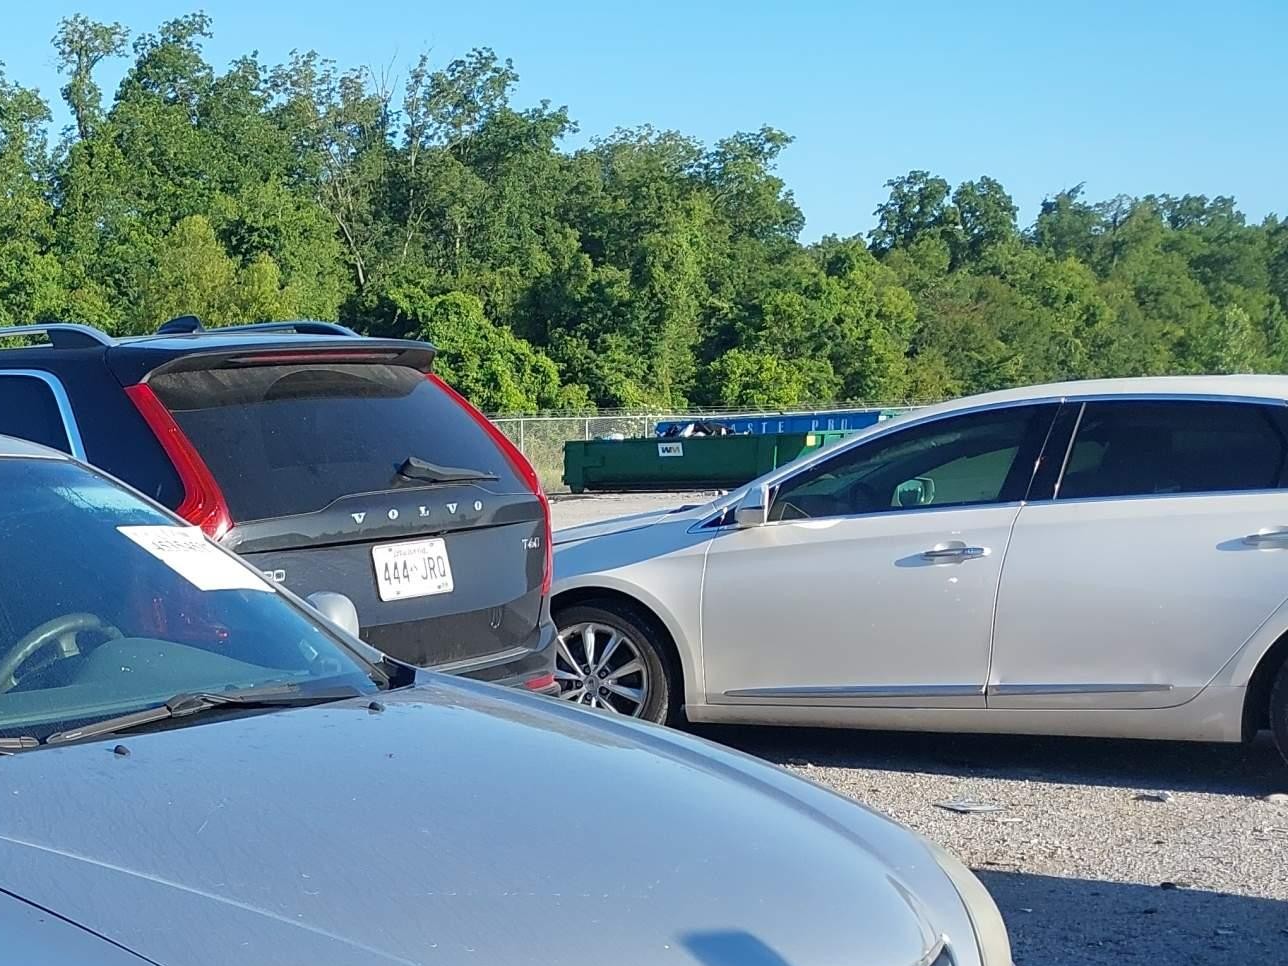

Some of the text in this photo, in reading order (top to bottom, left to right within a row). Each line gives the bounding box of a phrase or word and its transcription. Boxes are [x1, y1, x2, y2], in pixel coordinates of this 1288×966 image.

[730, 421, 785, 434] ASTE
[660, 446, 681, 454] WM
[352, 500, 482, 524] VOLVO
[383, 560, 411, 585] 444
